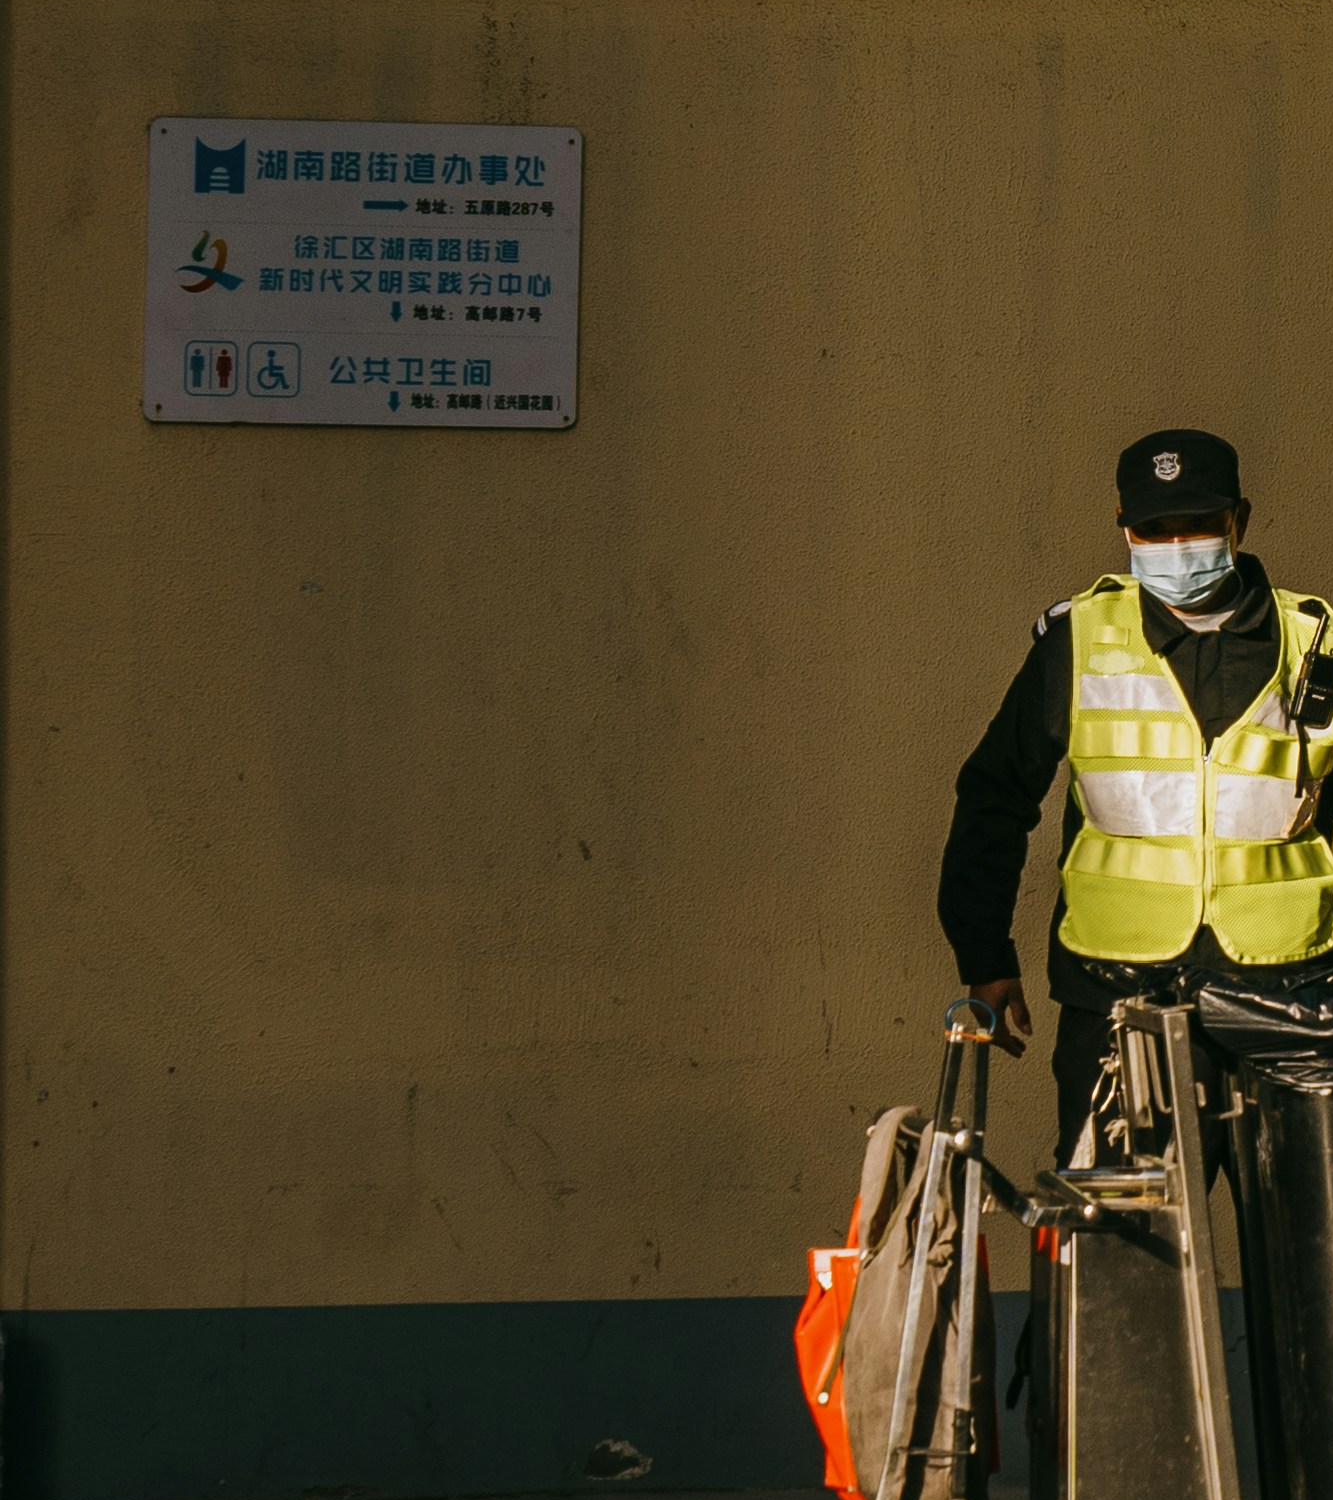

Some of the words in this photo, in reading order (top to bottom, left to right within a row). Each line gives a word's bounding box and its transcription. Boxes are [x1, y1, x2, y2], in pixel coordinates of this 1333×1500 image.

[257, 150, 546, 187] 湖南路街道办事处
[294, 235, 520, 264] 徐汇区湖南路街道
[259, 267, 552, 298] 新时代文明实践分中心
[329, 356, 492, 387] 公共卫生间
